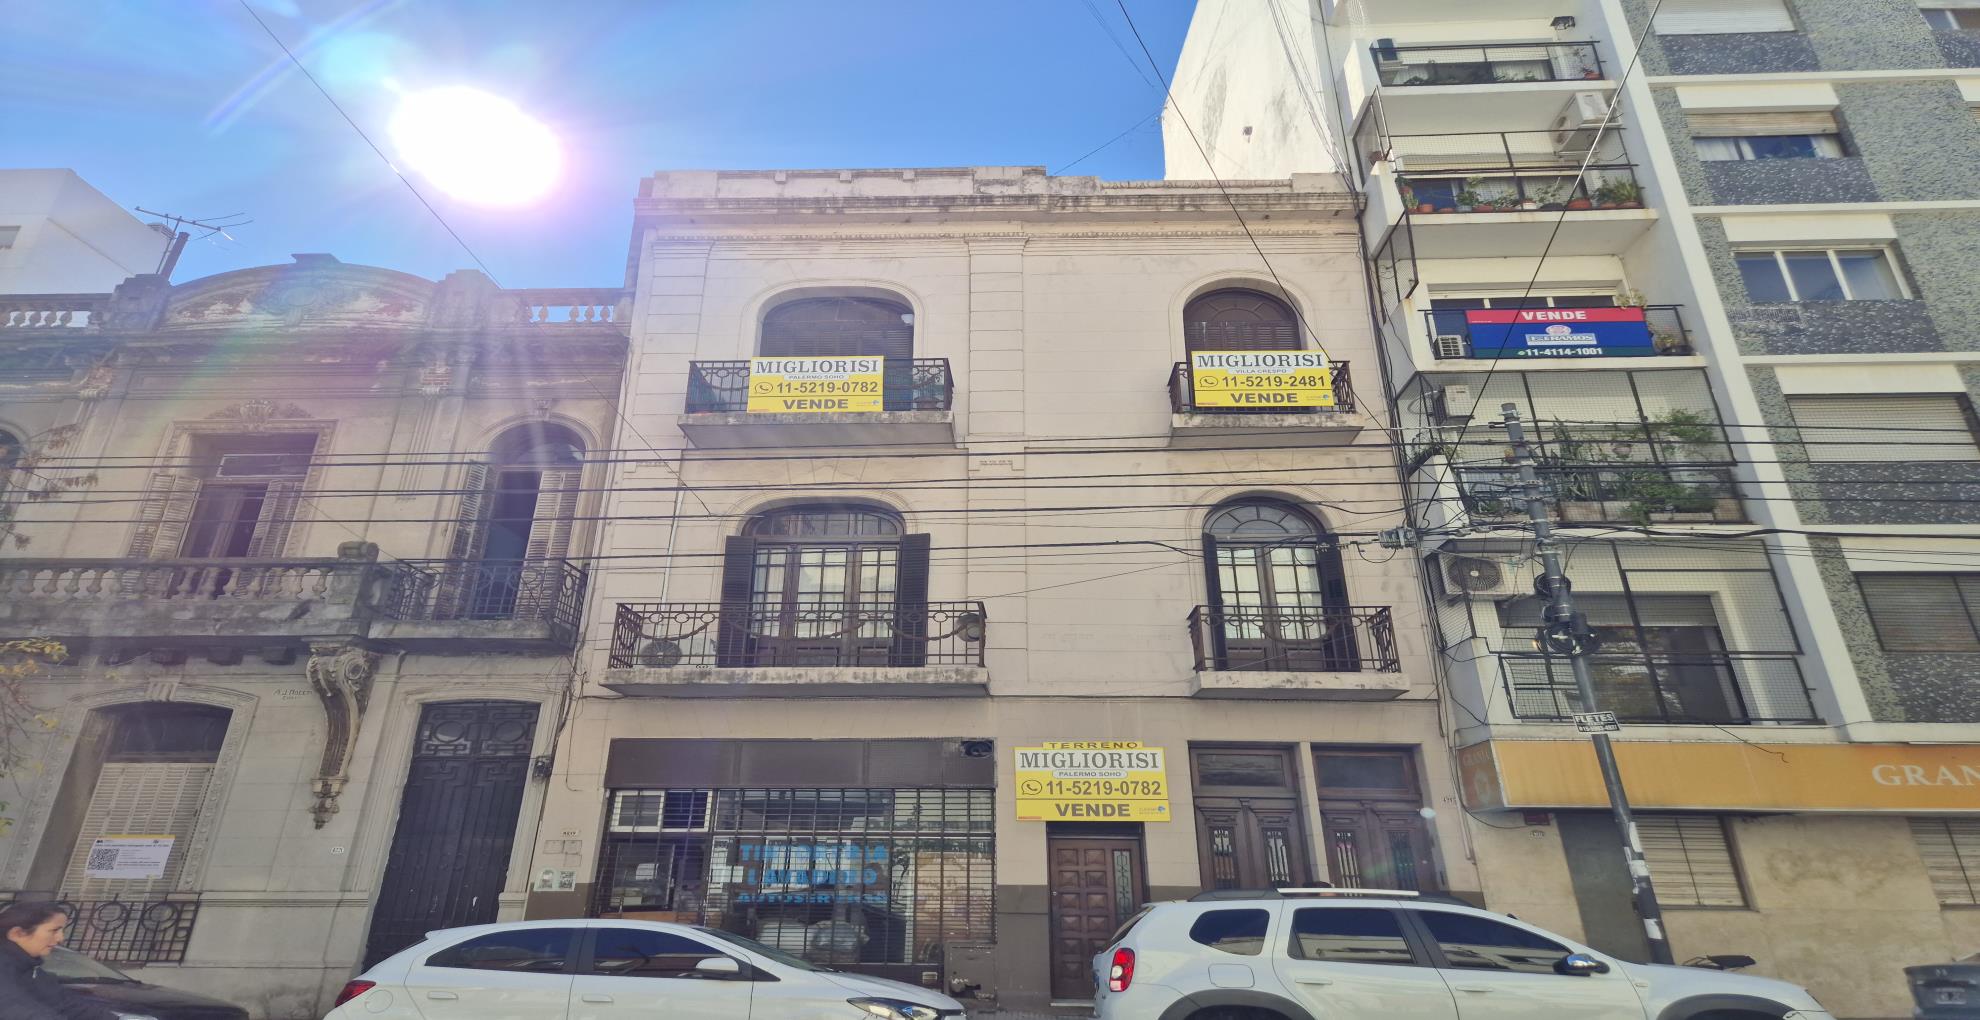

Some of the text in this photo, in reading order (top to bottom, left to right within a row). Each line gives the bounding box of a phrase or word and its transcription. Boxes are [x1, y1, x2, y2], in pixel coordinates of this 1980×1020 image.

[1521, 310, 1587, 321] VENDE
[1525, 347, 1603, 356] 11-4114-1001
[755, 359, 879, 374] MIGLIORISI
[1197, 354, 1323, 368] MIGLIORISI
[1222, 375, 1325, 387] 11-5219-2481
[777, 381, 878, 394] 11-5219-0782
[1230, 392, 1299, 403] VENDE
[783, 398, 849, 410] VENDE
[1574, 713, 1614, 723] FLETES
[1020, 752, 1160, 769] MIGLIORISI
[1046, 781, 1162, 796] 11-5219-0782
[1054, 803, 1131, 817] VENDE
